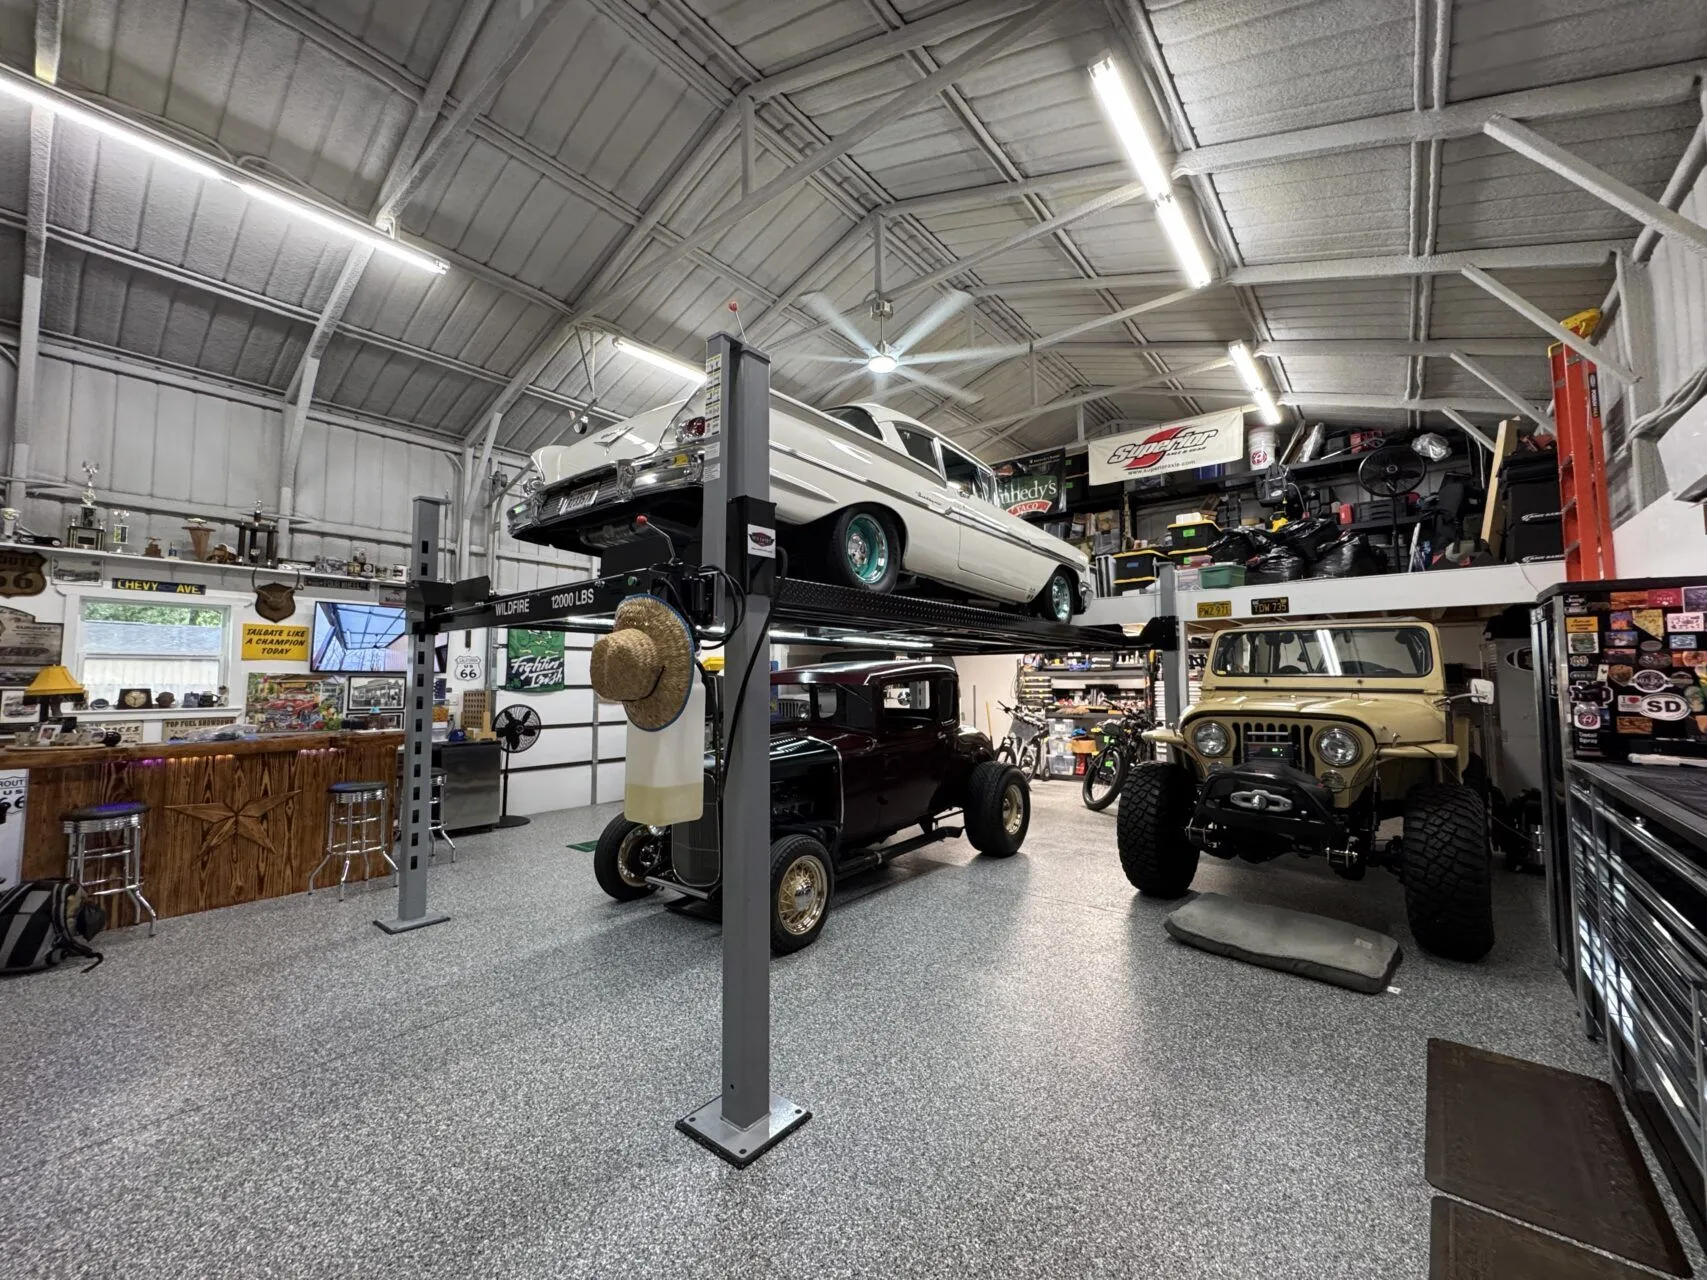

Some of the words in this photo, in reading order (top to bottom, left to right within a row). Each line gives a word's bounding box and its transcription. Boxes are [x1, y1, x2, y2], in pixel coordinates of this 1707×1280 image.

[1107, 429, 1219, 464] Superior
[117, 579, 159, 592] CHEVY
[176, 584, 200, 594] AVE
[551, 592, 574, 609] 12000
[575, 588, 594, 606] LBS
[495, 598, 530, 617] WILDFIRE
[246, 628, 284, 637] TAILGATE
[287, 630, 307, 638] LIKE
[255, 638, 305, 646] CHAMPION
[460, 669, 477, 678] 66
[523, 670, 563, 689] Irish
[1647, 700, 1682, 713] SD
